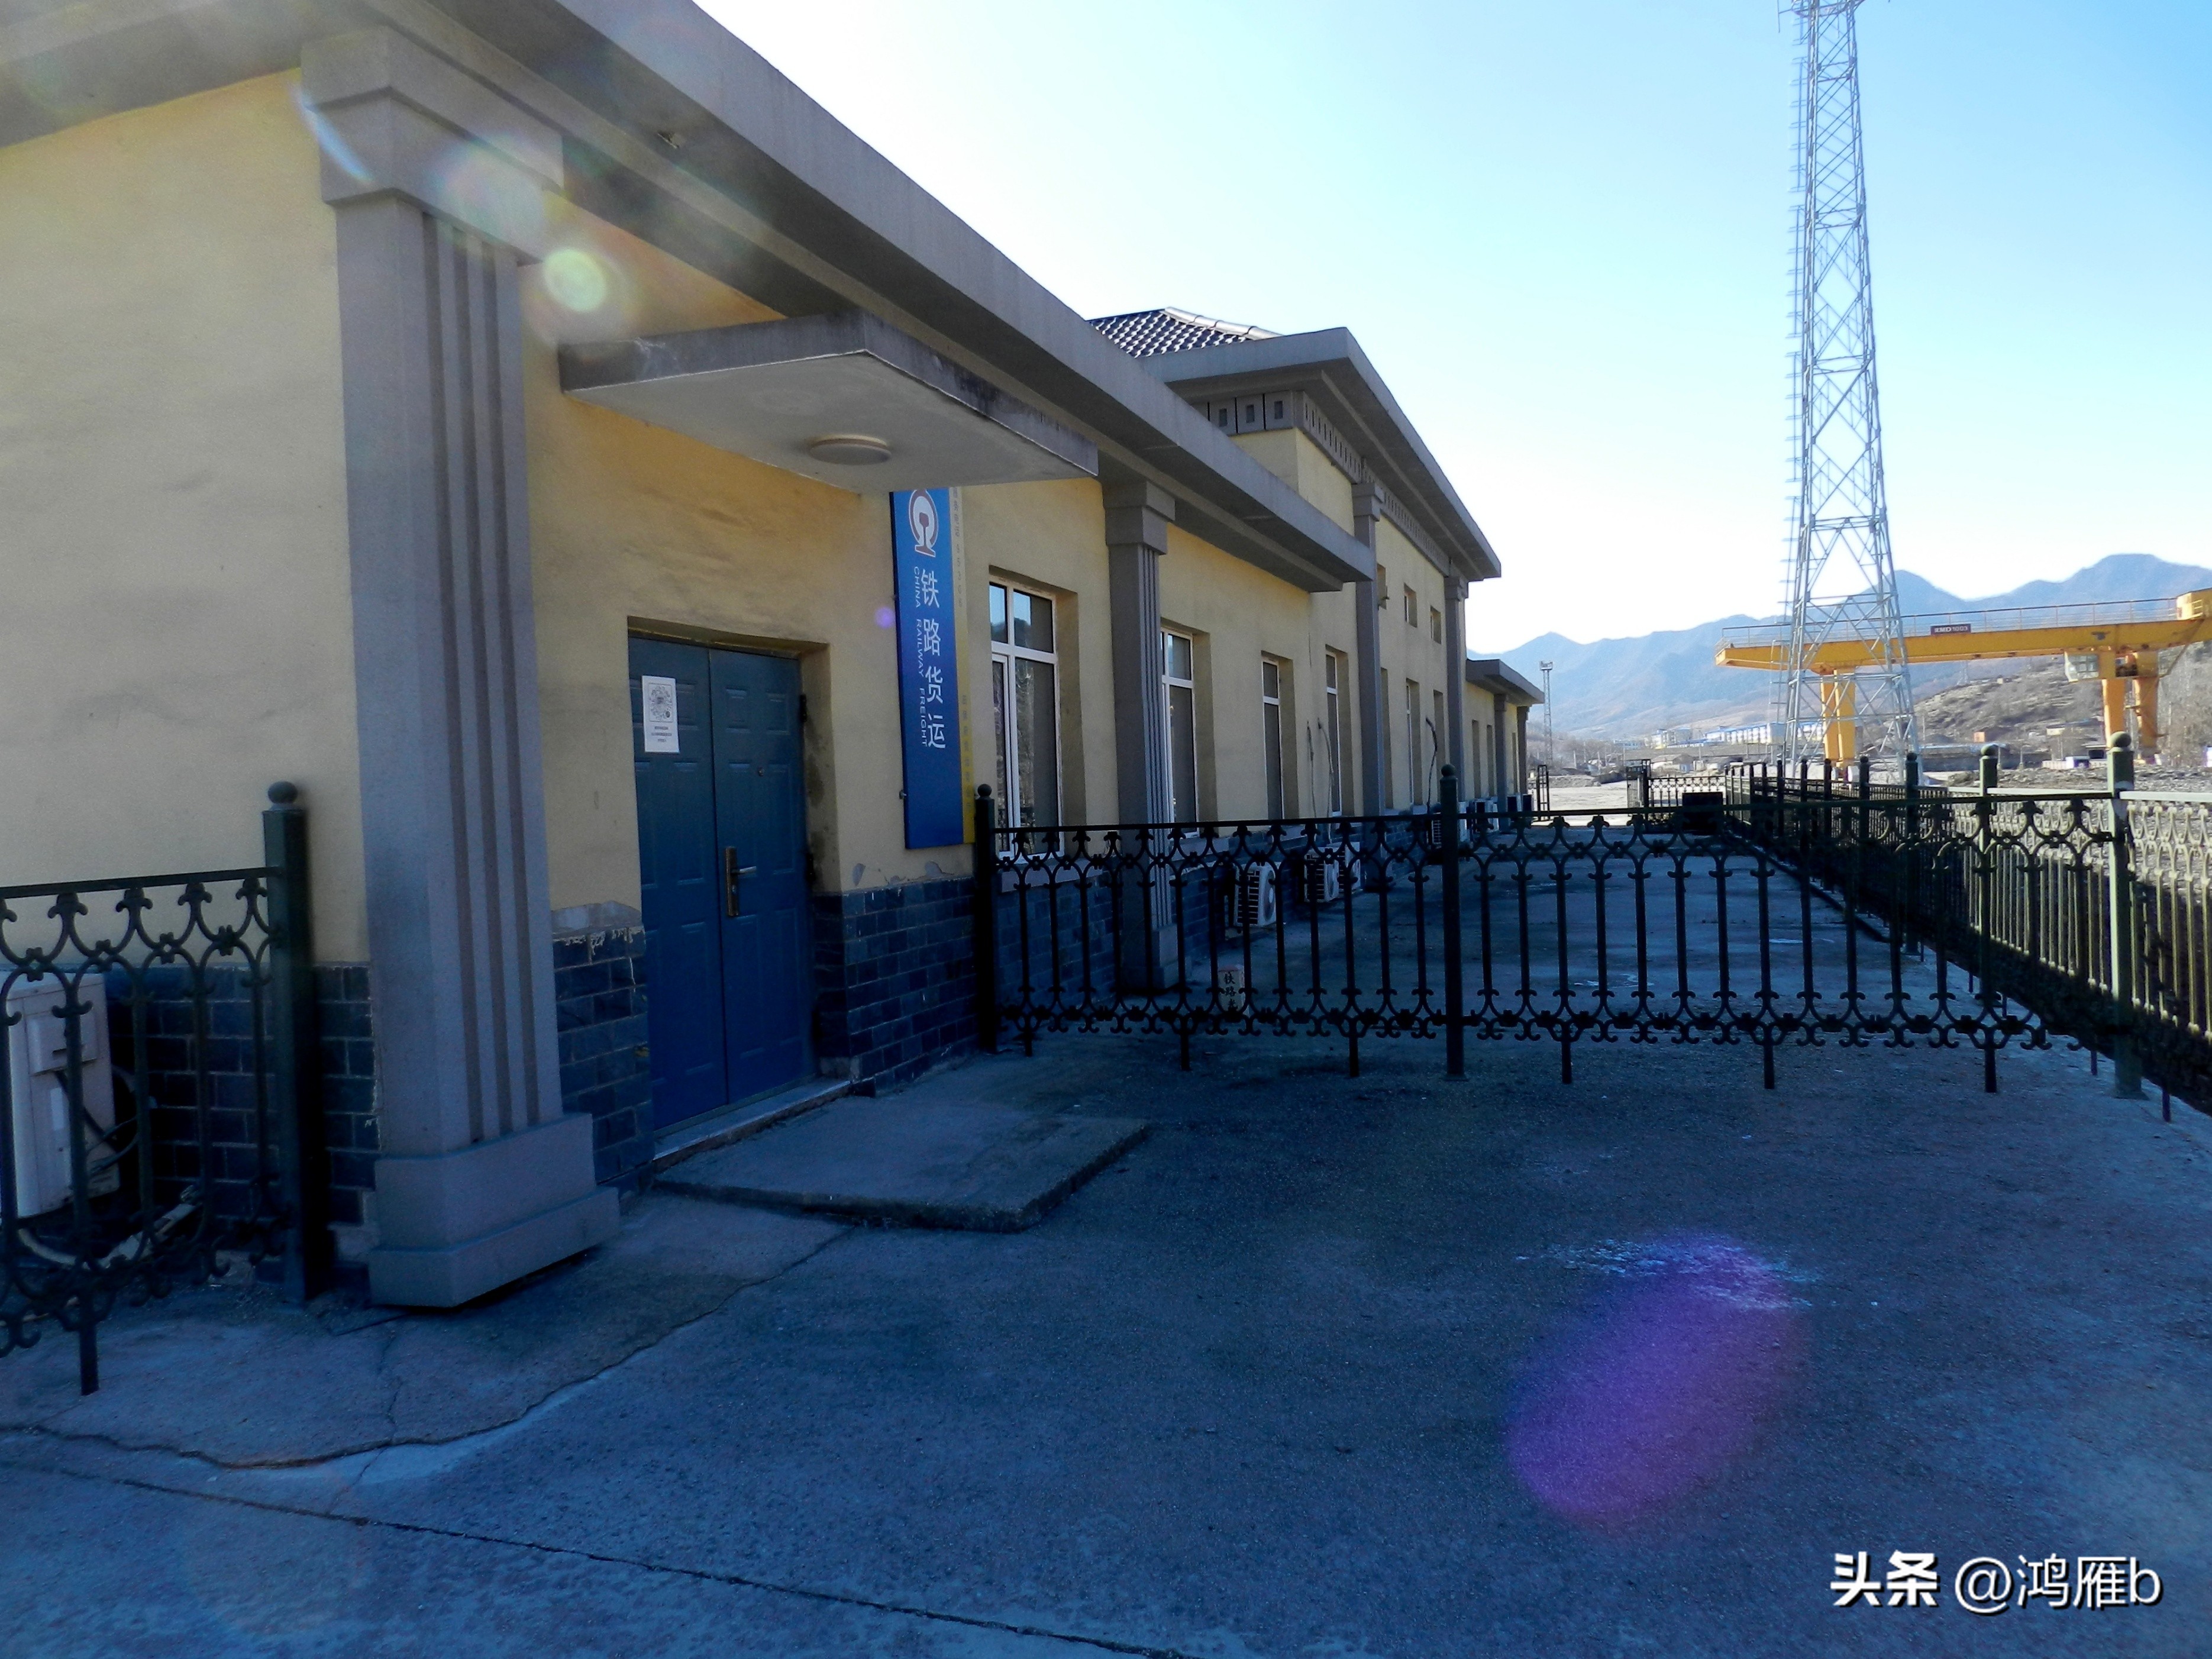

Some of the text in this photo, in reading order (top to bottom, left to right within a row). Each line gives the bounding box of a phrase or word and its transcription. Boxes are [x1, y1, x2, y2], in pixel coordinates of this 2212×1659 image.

[916, 619, 925, 677] RAILWAY
[921, 569, 945, 749] 铁路货运
[919, 688, 928, 747] FREIGHT
